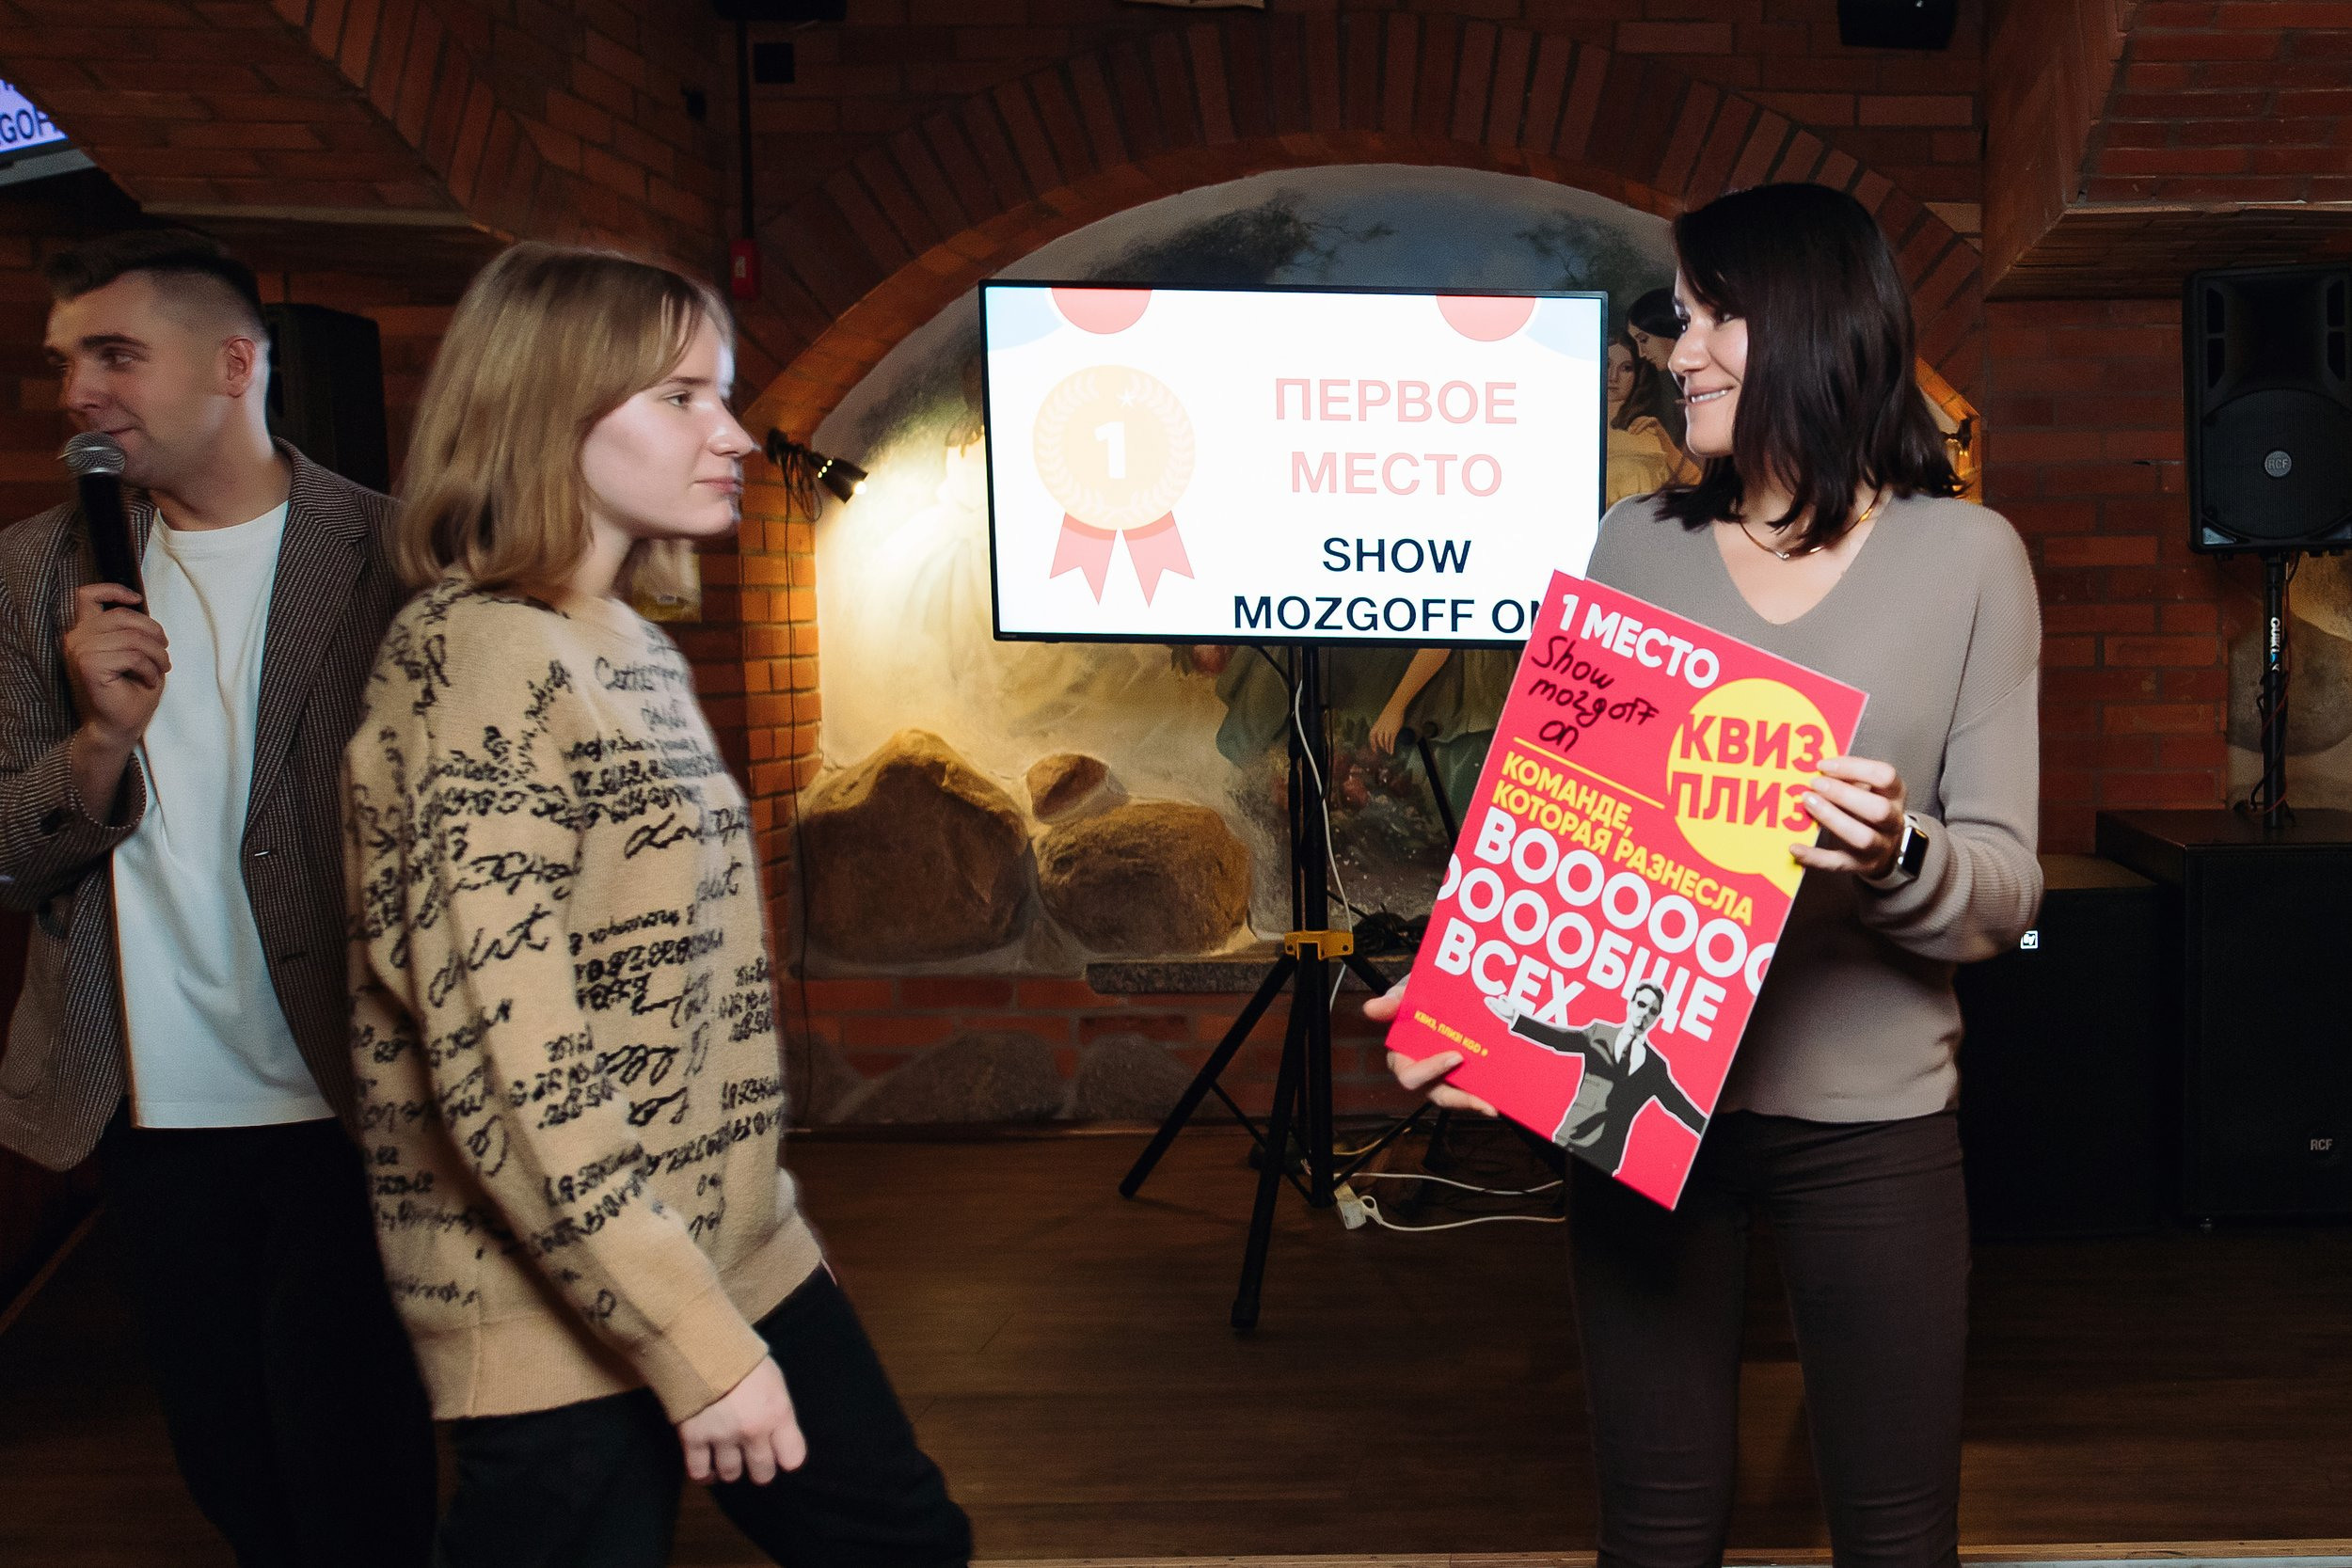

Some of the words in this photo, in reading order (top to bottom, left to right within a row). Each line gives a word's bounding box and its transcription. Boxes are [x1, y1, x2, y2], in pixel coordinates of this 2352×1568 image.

[1275, 377, 1518, 424] ПЕРВОЕ
[1094, 421, 1125, 479] 1
[1291, 451, 1502, 497] МЕСТО
[2268, 459, 2290, 469] RCF
[1323, 537, 1471, 574] SHOW
[1233, 595, 1475, 633] MOZGOFF
[1491, 599, 1542, 633] O
[1562, 594, 1580, 631] 1
[1581, 604, 1720, 689] МЕСТО
[1532, 635, 1614, 690] Show
[1539, 720, 1580, 752] on
[1680, 714, 1824, 773] КВИЗ
[1502, 751, 1633, 839] КОМАНДЕ,
[1671, 770, 1813, 832] ПЛИЗ
[1492, 781, 1612, 857] КОТОРАЯ
[1613, 836, 1754, 927] РАЗНЕСЛА
[1435, 917, 1585, 1026] ВСЕХ
[2310, 1138, 2333, 1150] RCF
